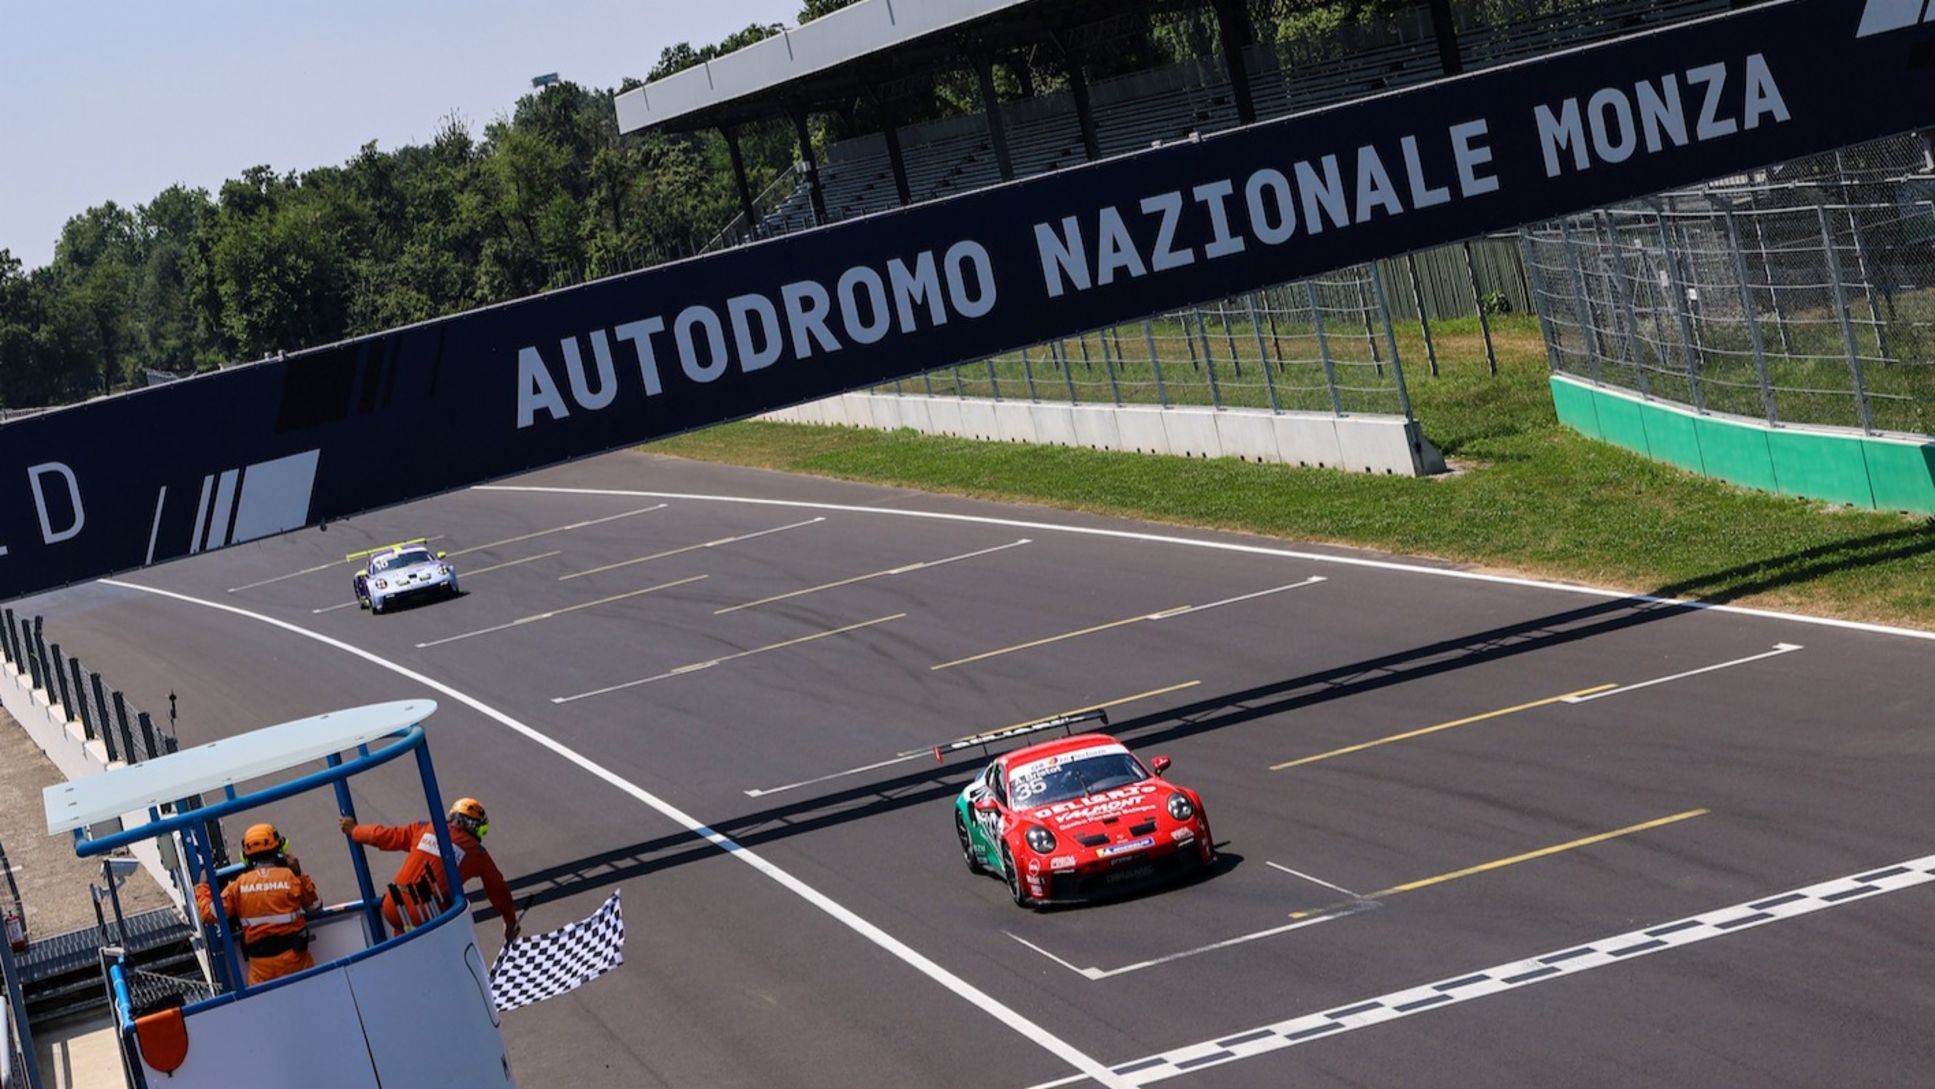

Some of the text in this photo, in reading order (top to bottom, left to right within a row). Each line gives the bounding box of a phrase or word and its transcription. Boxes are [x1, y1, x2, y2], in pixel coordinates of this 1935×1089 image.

[517, 53, 1791, 428] AUTODROMO NAZIONALE MONZA
[1014, 781, 1048, 801] 35
[1055, 795, 1145, 823] VALMONT
[239, 880, 291, 895] MARSHAL
